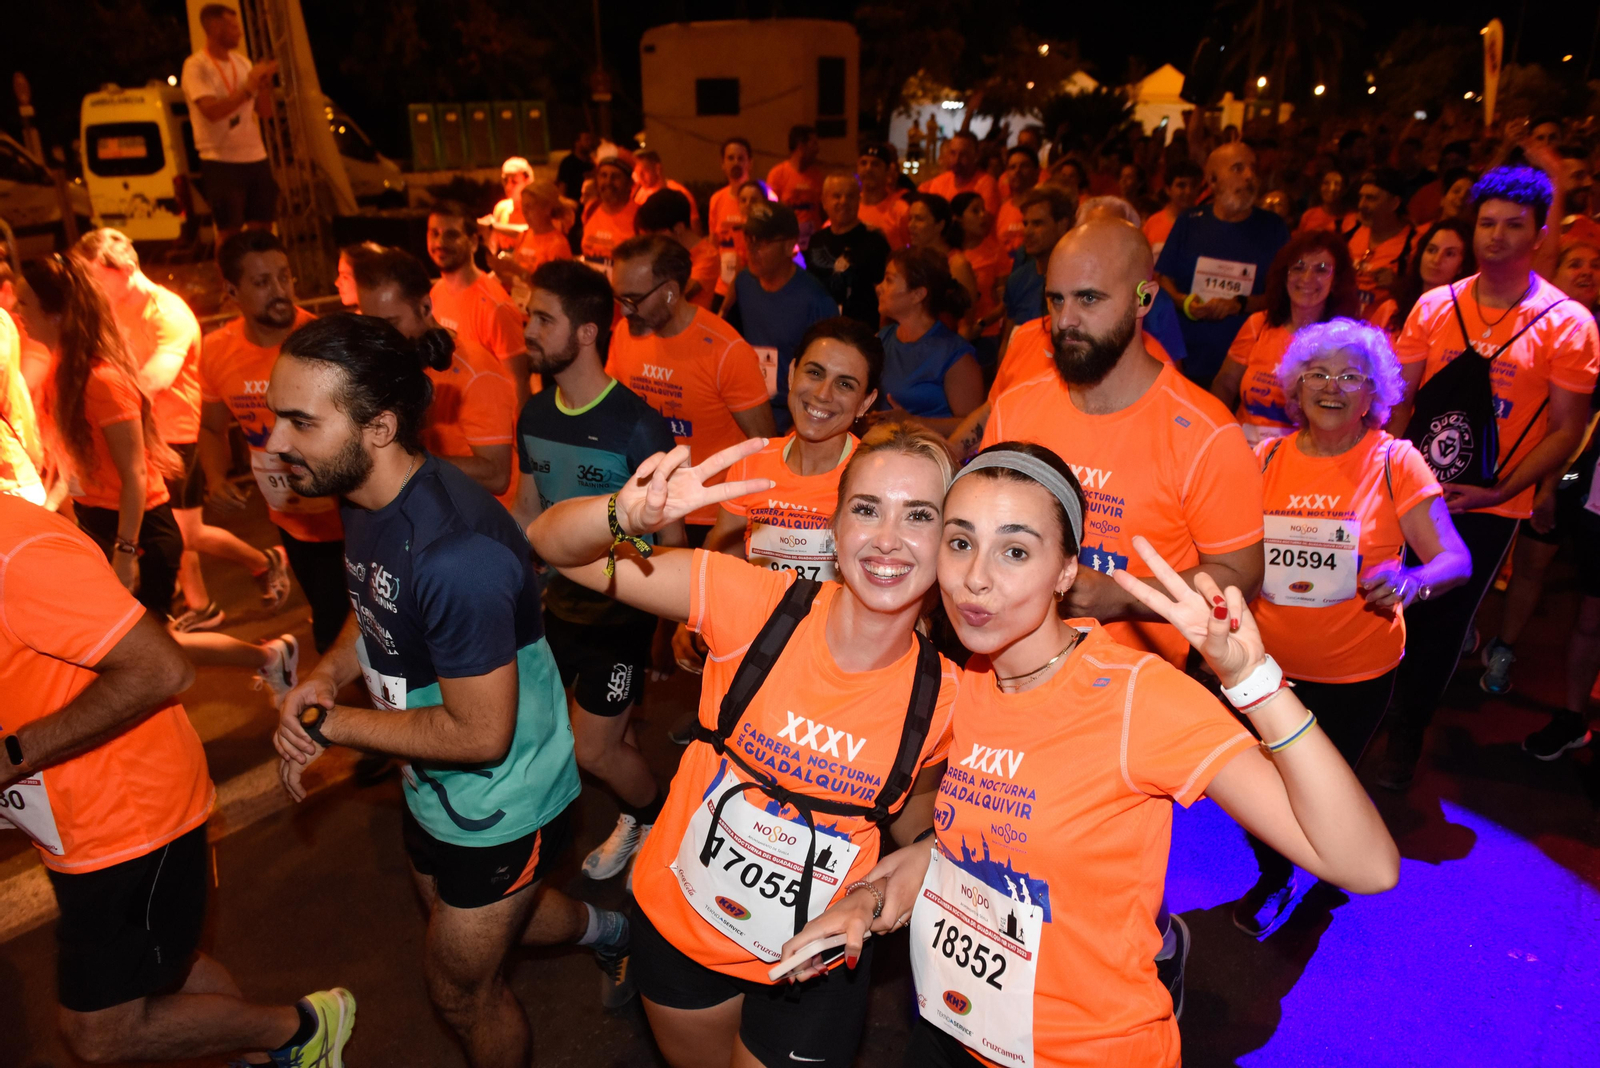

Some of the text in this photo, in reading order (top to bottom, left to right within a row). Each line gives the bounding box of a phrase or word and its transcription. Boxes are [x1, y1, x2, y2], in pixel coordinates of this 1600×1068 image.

[1205, 277, 1242, 293] 11458
[642, 363, 673, 381] XXXV
[243, 381, 269, 394] XXX
[577, 464, 604, 482] 365
[1068, 463, 1113, 489] XXV
[578, 481, 610, 489] TRAINING
[1082, 490, 1125, 506] OCTURNA
[1286, 494, 1341, 509] XXXV
[750, 508, 829, 522] CARRERA NOCTURN
[752, 516, 828, 530] GUADALQUIVI
[1263, 509, 1303, 517] CARRERA
[1269, 548, 1337, 571] 20594
[607, 672, 627, 702] 365
[736, 732, 746, 748] DEL
[777, 710, 867, 762] XXXV
[743, 722, 881, 787] CARRERA NOCTURNA
[960, 743, 1025, 779] XXXV
[743, 741, 875, 802] GUADALQUIVIR
[940, 779, 1032, 820] GUADALQUIVIR
[980, 778, 1037, 801] NOCTURNA
[719, 818, 734, 837] ARRERA
[734, 833, 762, 856] NOCTURNA
[762, 852, 772, 860] DEL
[772, 857, 804, 873] GUADALQUI
[711, 836, 801, 907] 17055
[931, 918, 1007, 991] 18352
[982, 1038, 1024, 1061] Cruzcampo
